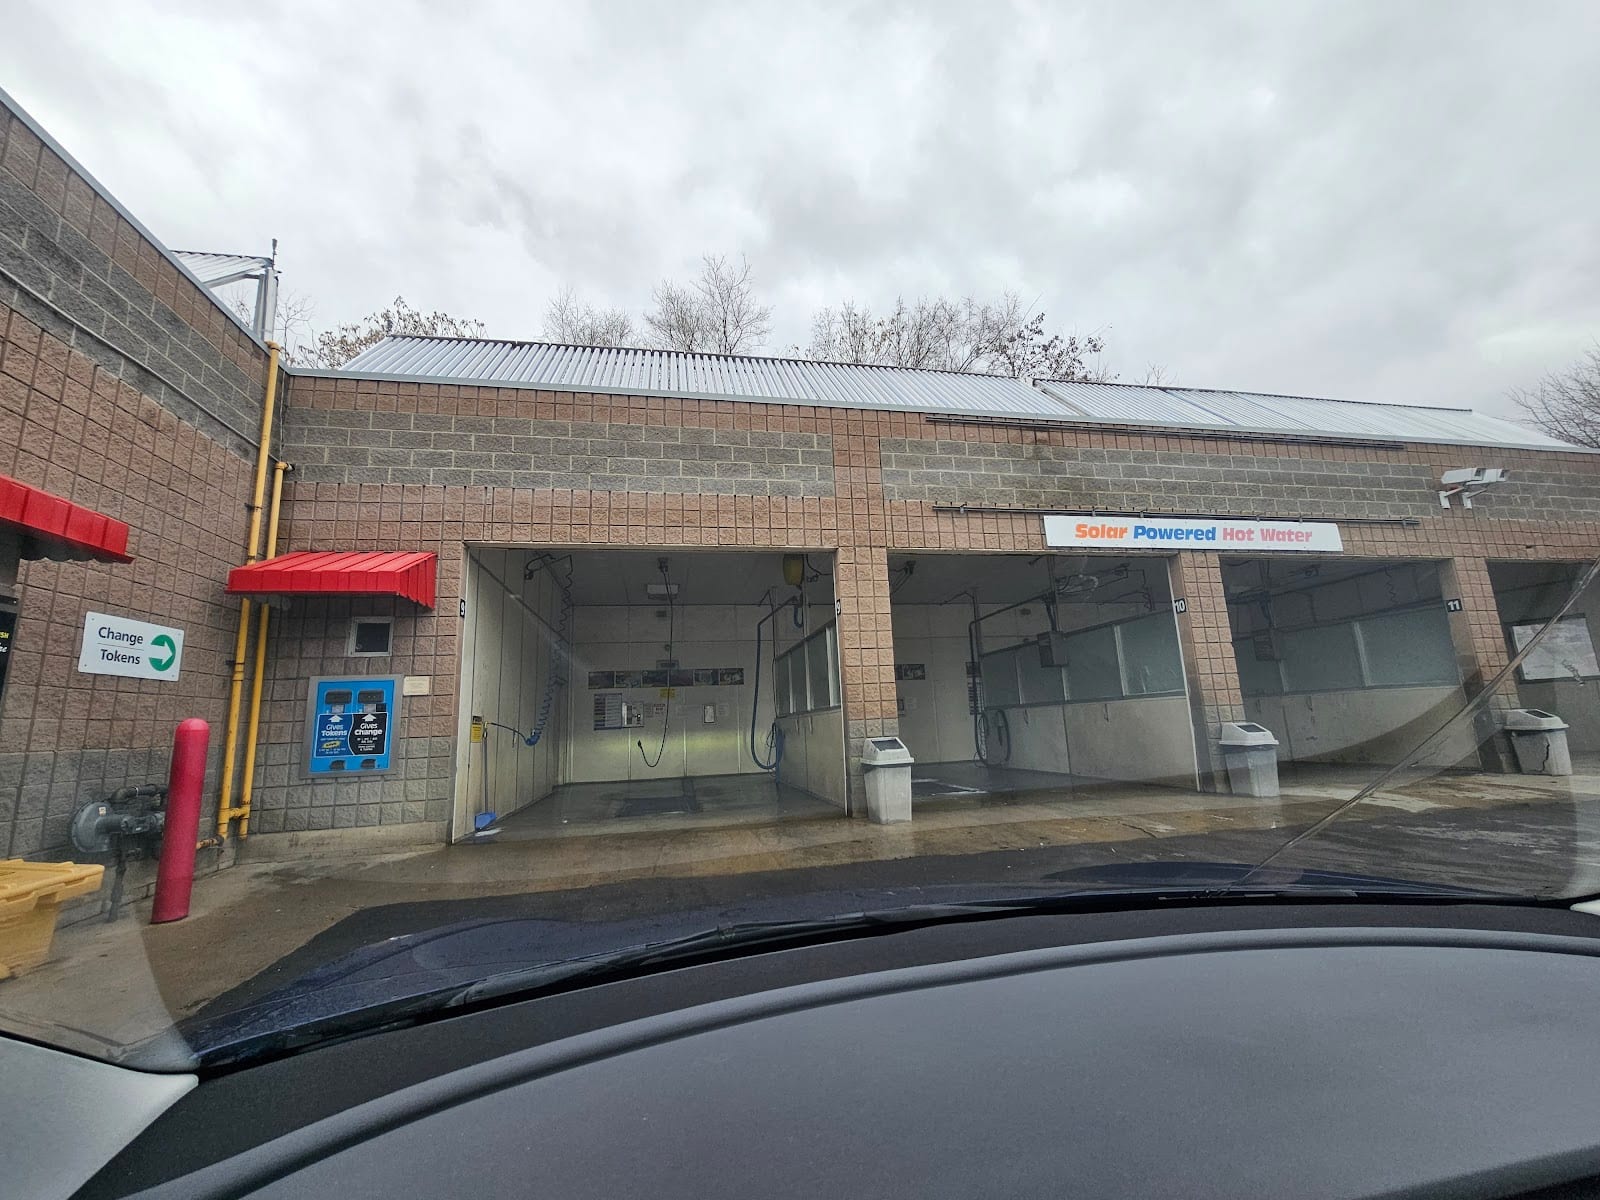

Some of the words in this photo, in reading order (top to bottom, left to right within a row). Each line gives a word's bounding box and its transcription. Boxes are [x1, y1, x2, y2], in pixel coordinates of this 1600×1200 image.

[1075, 523, 1128, 539] Solar
[1133, 525, 1216, 541] Powered
[1222, 527, 1255, 541] Hot
[1260, 528, 1313, 542] Water
[1175, 600, 1185, 612] 10
[1447, 600, 1460, 611] 11
[98, 626, 144, 646] Change
[100, 649, 141, 665] Tokens
[360, 722, 378, 730] Gives
[354, 729, 383, 737] Change
